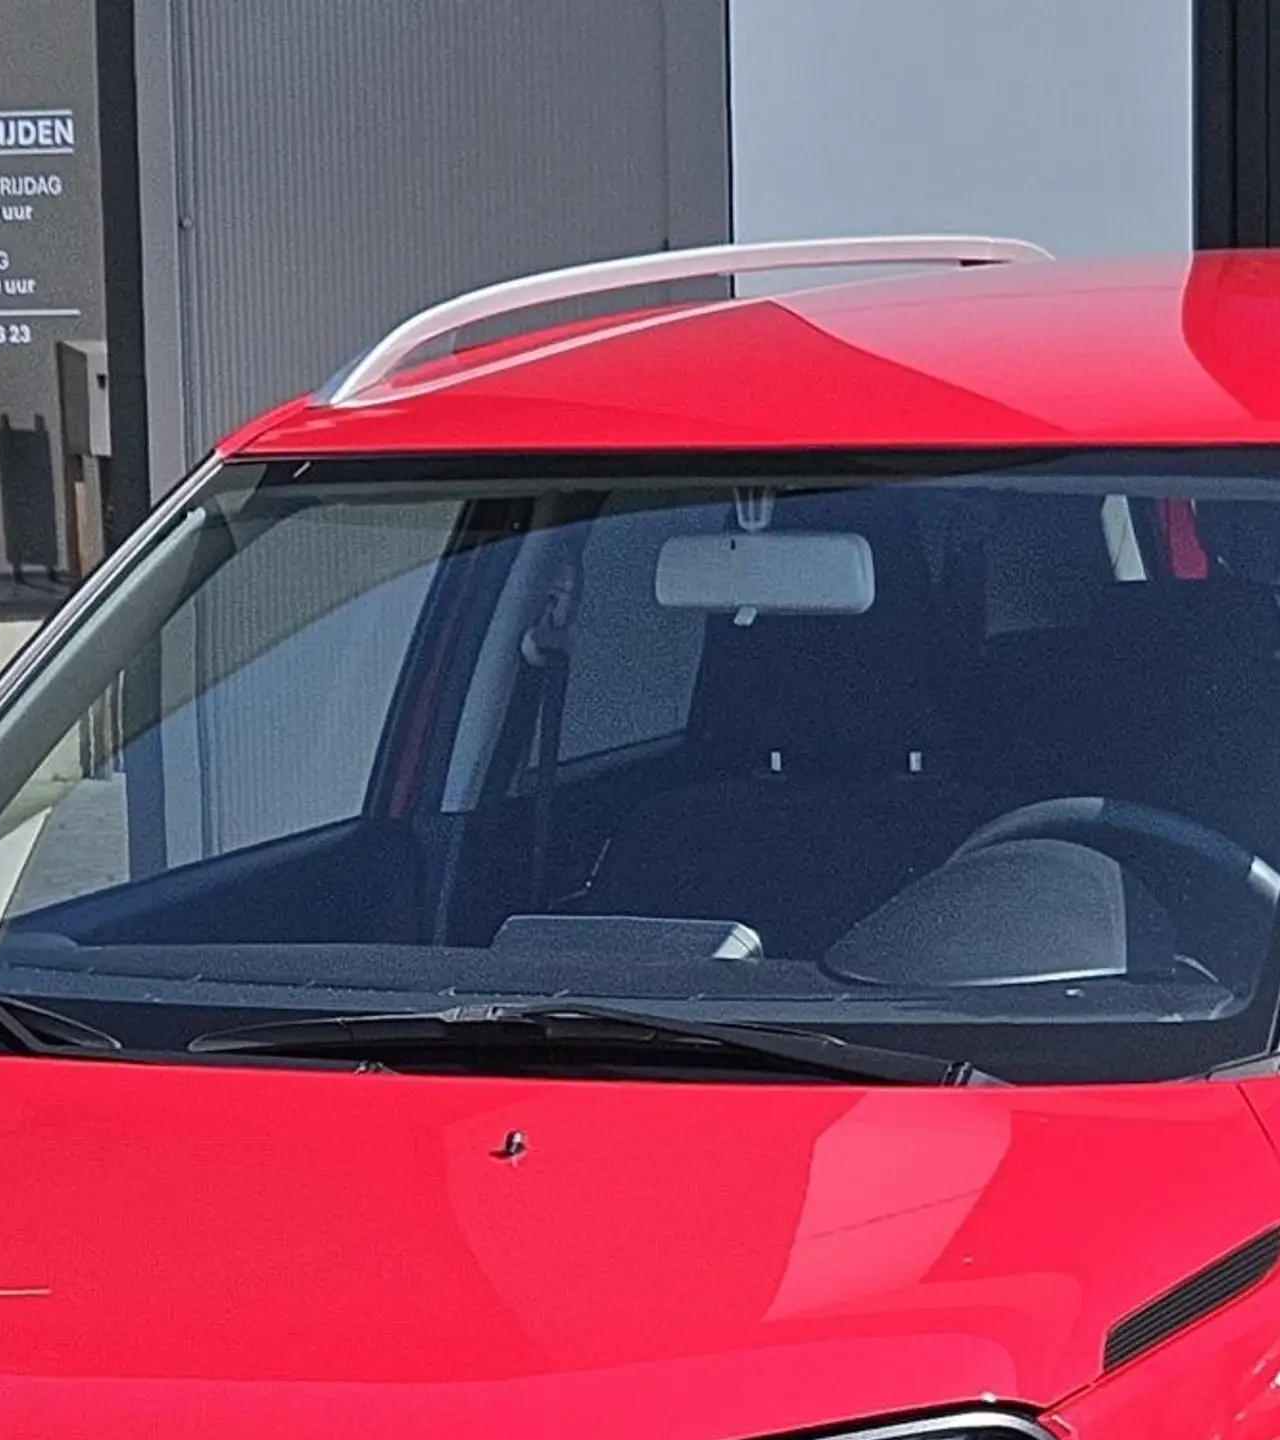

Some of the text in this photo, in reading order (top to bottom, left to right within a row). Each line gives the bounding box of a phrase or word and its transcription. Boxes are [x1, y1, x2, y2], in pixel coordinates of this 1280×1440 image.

[2, 204, 34, 221] uur
[4, 277, 37, 294] uur
[8, 323, 32, 344] 23
